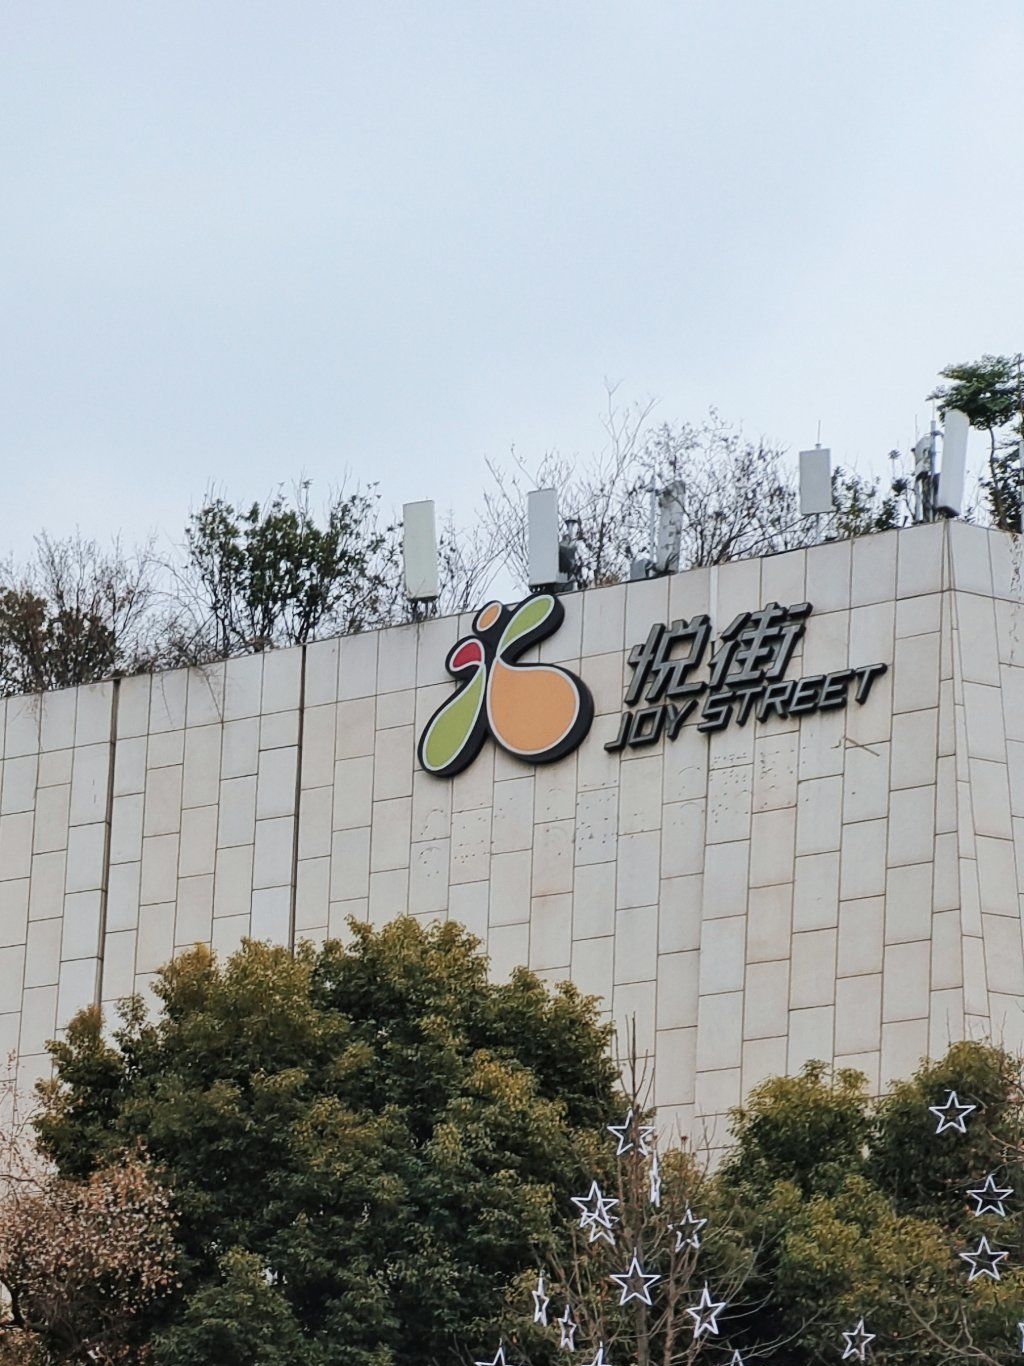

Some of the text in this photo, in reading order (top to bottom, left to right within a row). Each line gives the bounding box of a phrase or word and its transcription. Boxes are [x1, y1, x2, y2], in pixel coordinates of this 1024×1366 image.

[624, 601, 813, 706] 悦街
[604, 662, 889, 752] JOY STREET
